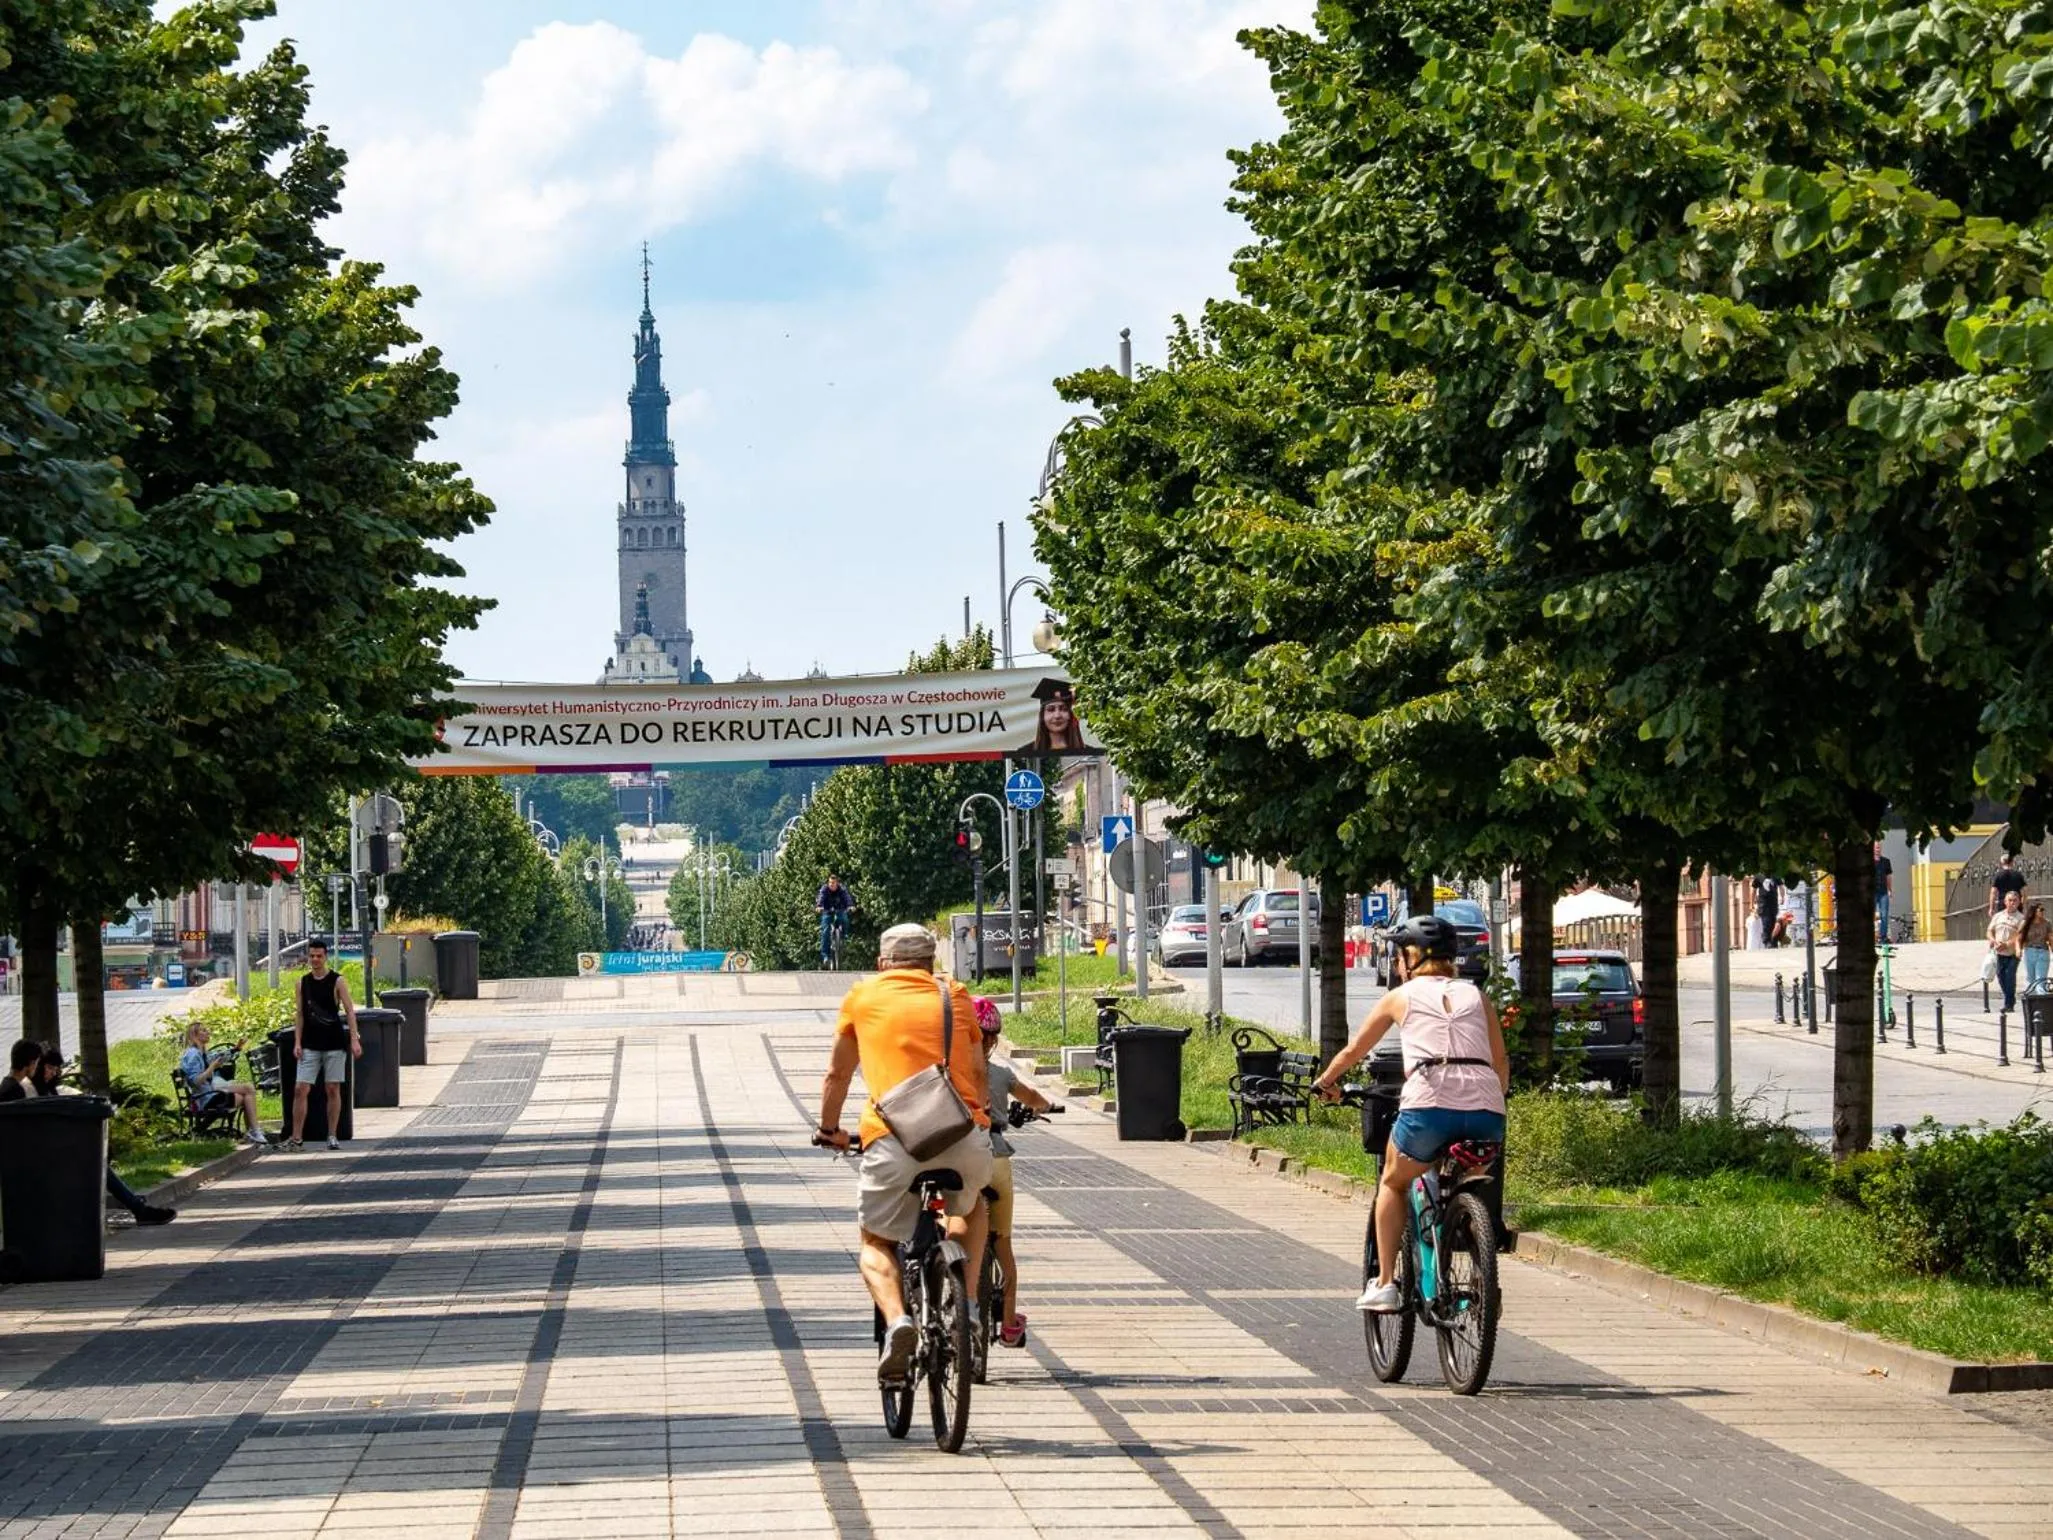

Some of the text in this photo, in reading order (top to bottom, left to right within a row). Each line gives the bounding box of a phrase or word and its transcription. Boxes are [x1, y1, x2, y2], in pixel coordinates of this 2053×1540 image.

[474, 687, 1006, 716] niwersytet Humanistyczno-Przyrodniczy im. Jana Długosza w Częstochowie
[463, 710, 1006, 747] ZAPRASZA DO REKRUTACJI NA STUDIA
[1368, 896, 1383, 916] P
[637, 952, 682, 966] jurajski
